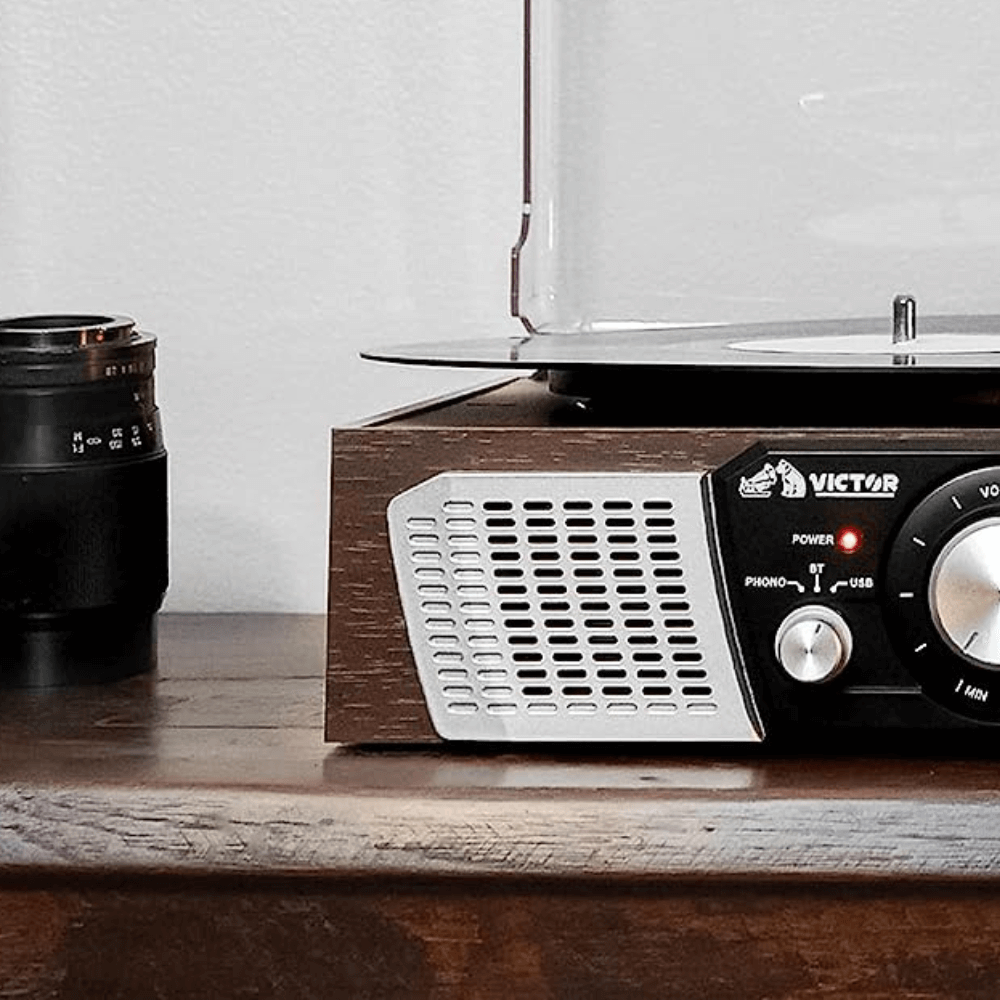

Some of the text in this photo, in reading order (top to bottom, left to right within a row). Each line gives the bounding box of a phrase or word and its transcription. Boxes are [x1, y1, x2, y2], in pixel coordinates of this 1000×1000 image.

[808, 473, 900, 492] VICTOR
[791, 533, 834, 546] POWER
[809, 563, 825, 574] BT
[744, 576, 786, 588] PHONO
[849, 577, 874, 588] USB
[964, 684, 989, 702] MIN
